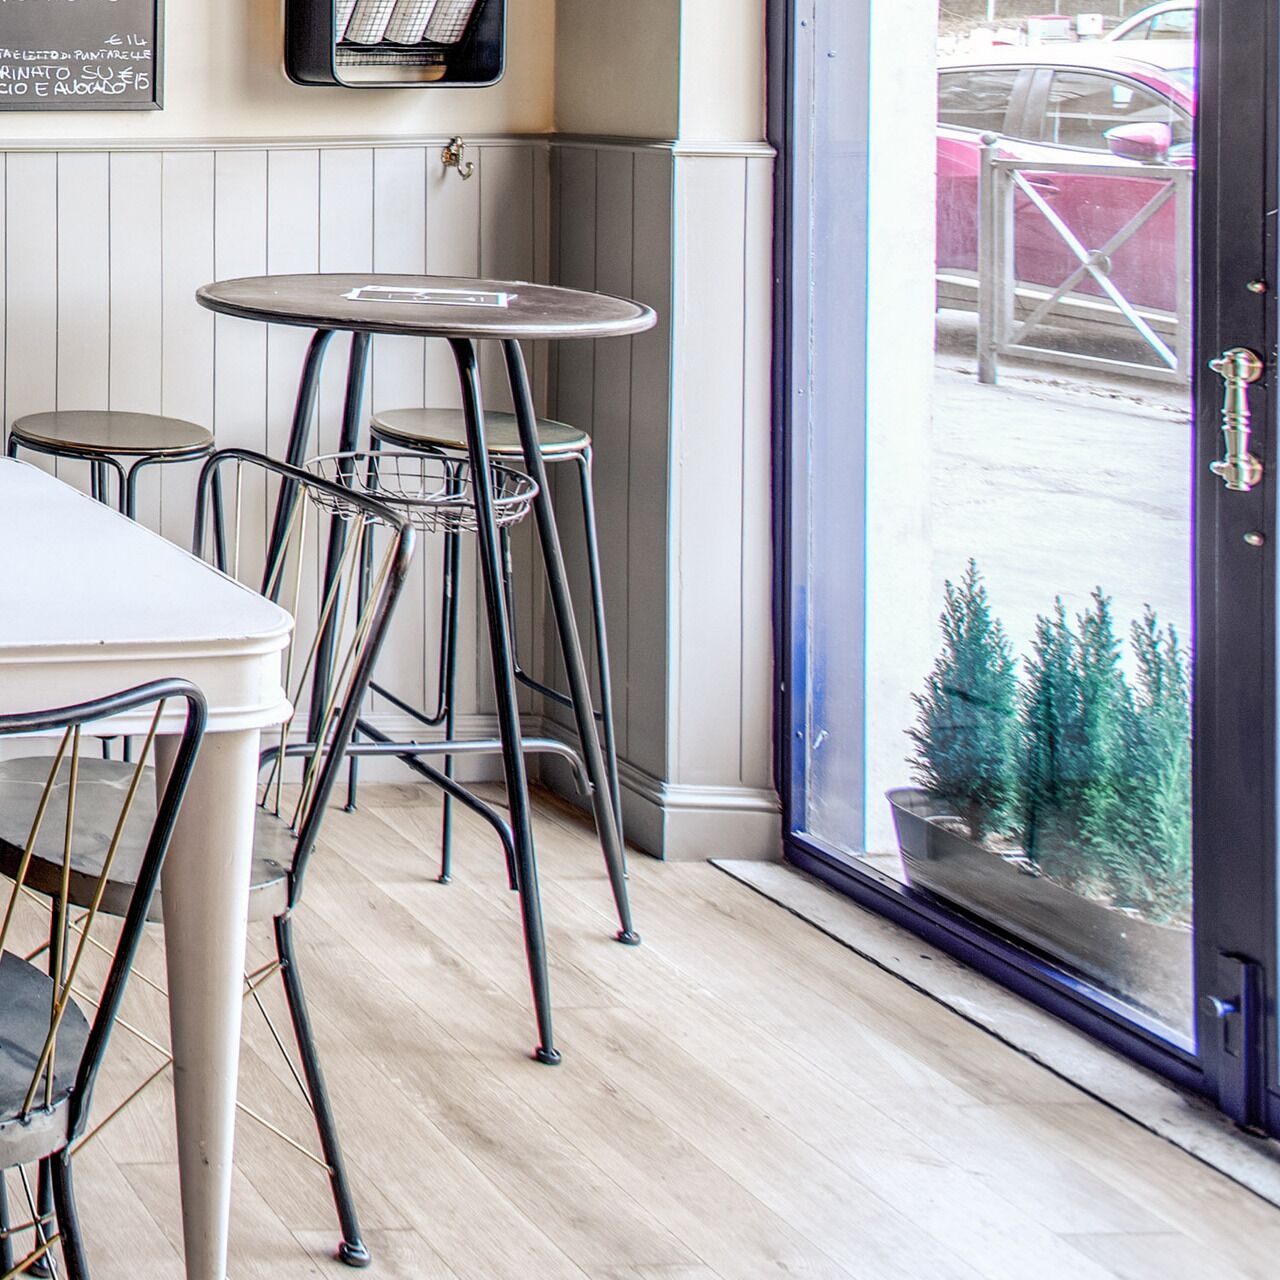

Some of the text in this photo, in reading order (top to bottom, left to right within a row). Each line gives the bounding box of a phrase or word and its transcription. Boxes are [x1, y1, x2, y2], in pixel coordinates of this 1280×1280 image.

[59, 52, 72, 60] DI
[80, 65, 114, 82] SU
[35, 82, 49, 97] E
[54, 80, 127, 95] AVOCADO
